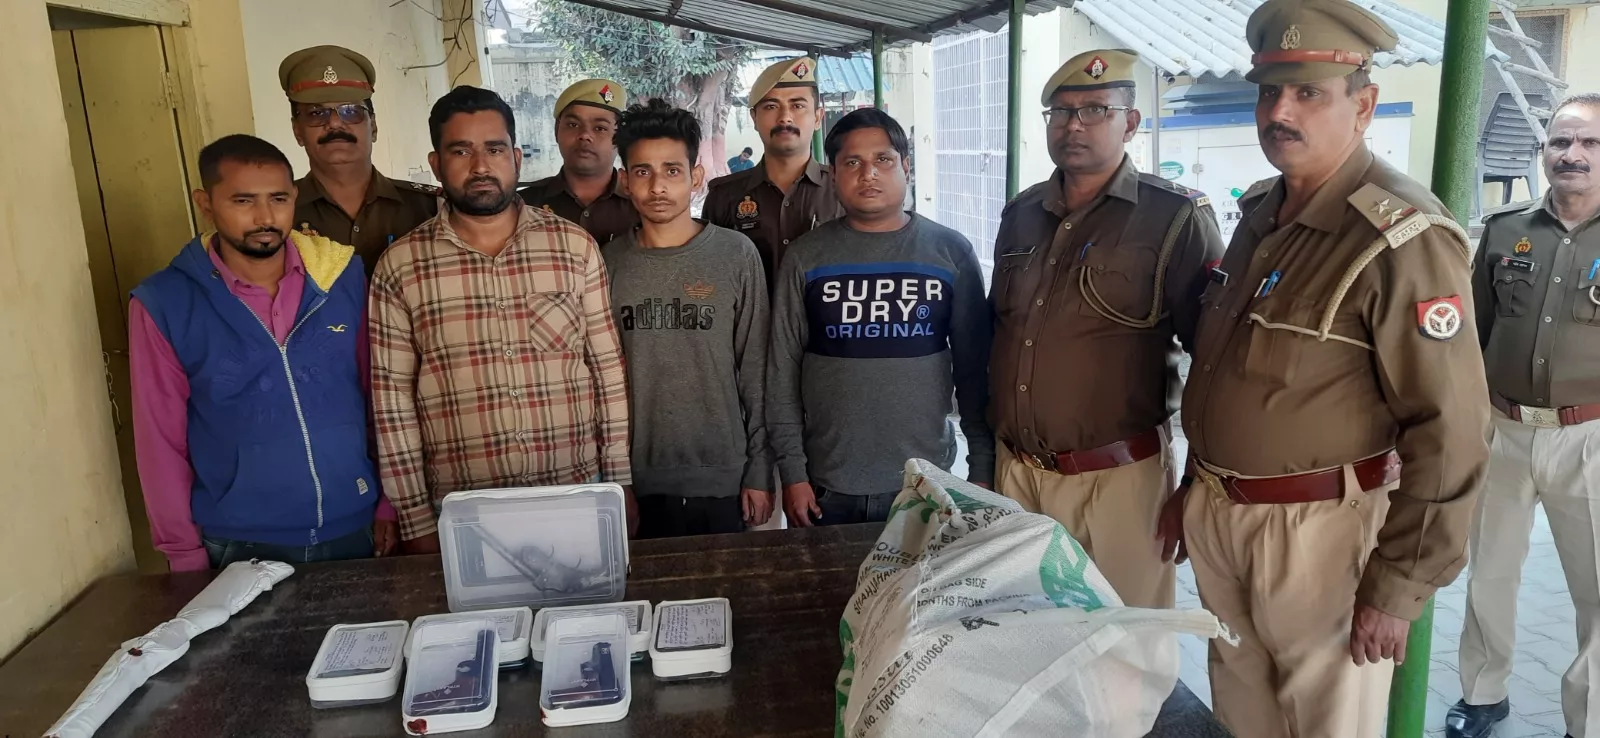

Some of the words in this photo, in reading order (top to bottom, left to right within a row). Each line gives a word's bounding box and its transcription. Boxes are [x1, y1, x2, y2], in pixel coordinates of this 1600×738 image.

[822, 279, 943, 303] SUPER
[620, 298, 716, 331] adidas
[825, 322, 935, 340] ORIGINAL
[853, 567, 901, 615] SHAHJAHAN
[965, 577, 988, 589] SIDE
[955, 594, 984, 609] FROM
[876, 633, 954, 714] 10013051000648
